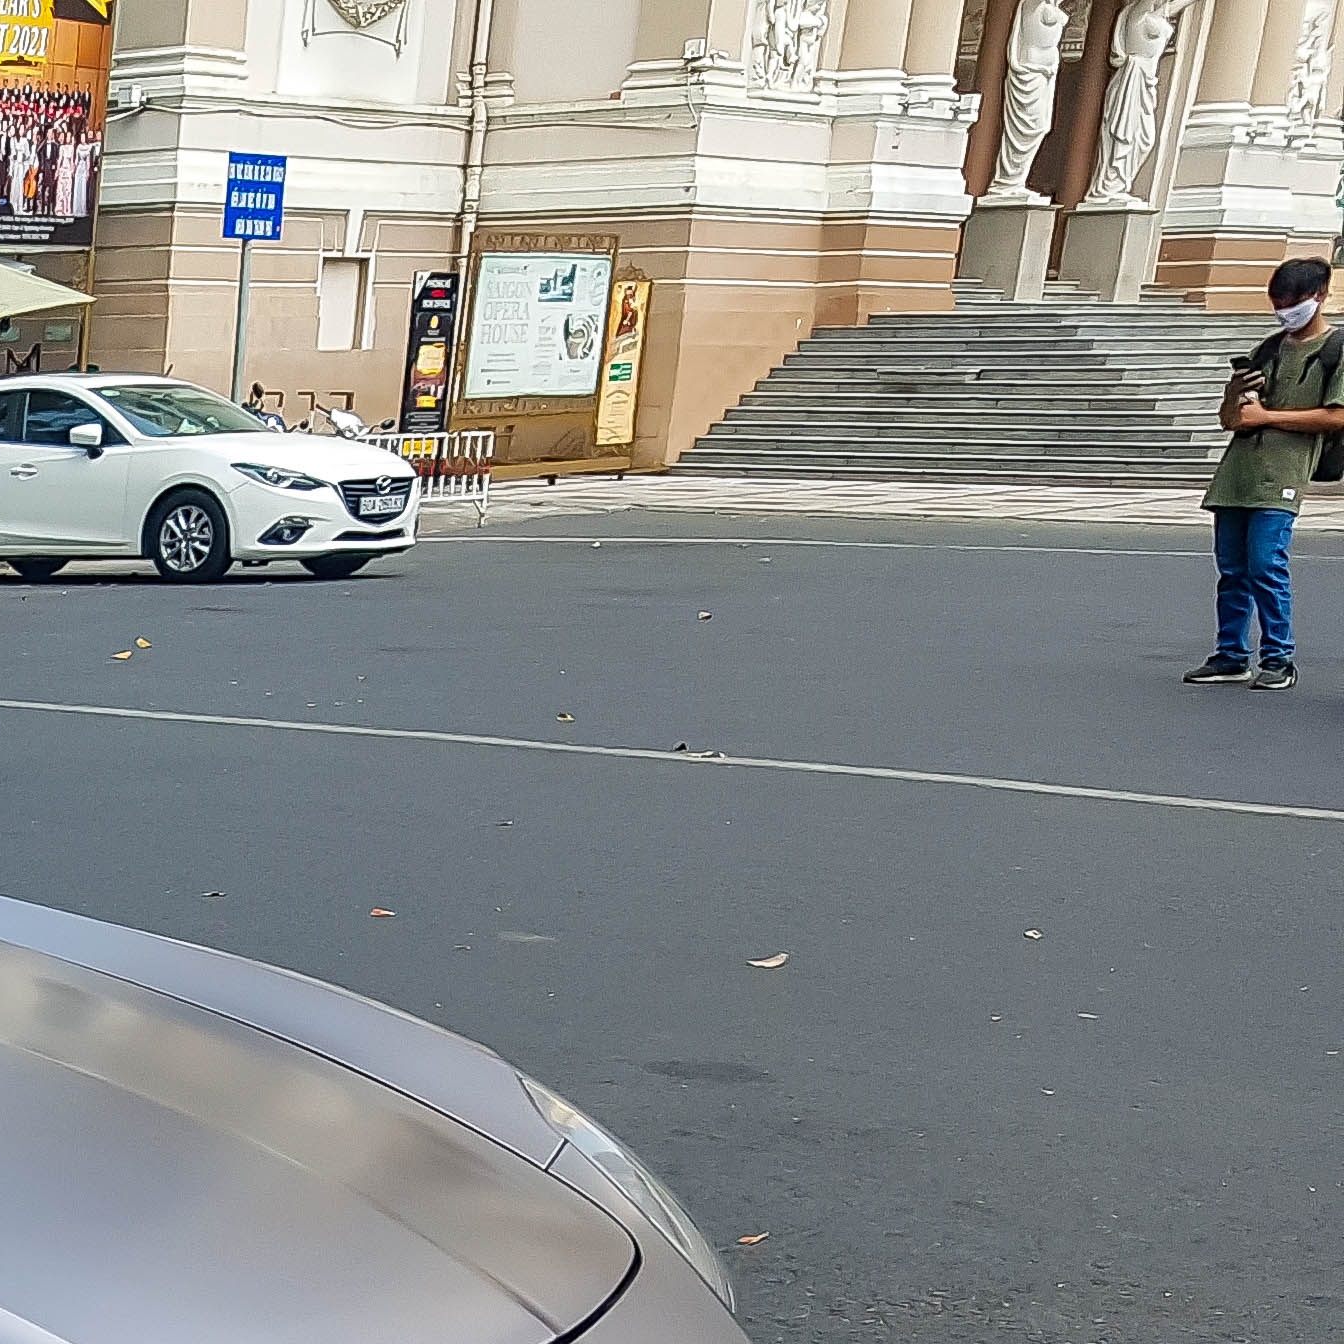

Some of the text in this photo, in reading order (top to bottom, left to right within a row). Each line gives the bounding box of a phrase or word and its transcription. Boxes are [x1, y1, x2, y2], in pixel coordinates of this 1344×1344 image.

[9, 23, 48, 57] 2021
[486, 280, 532, 299] SAIGON
[482, 301, 530, 321] OPERA
[480, 323, 529, 345] HOUSE
